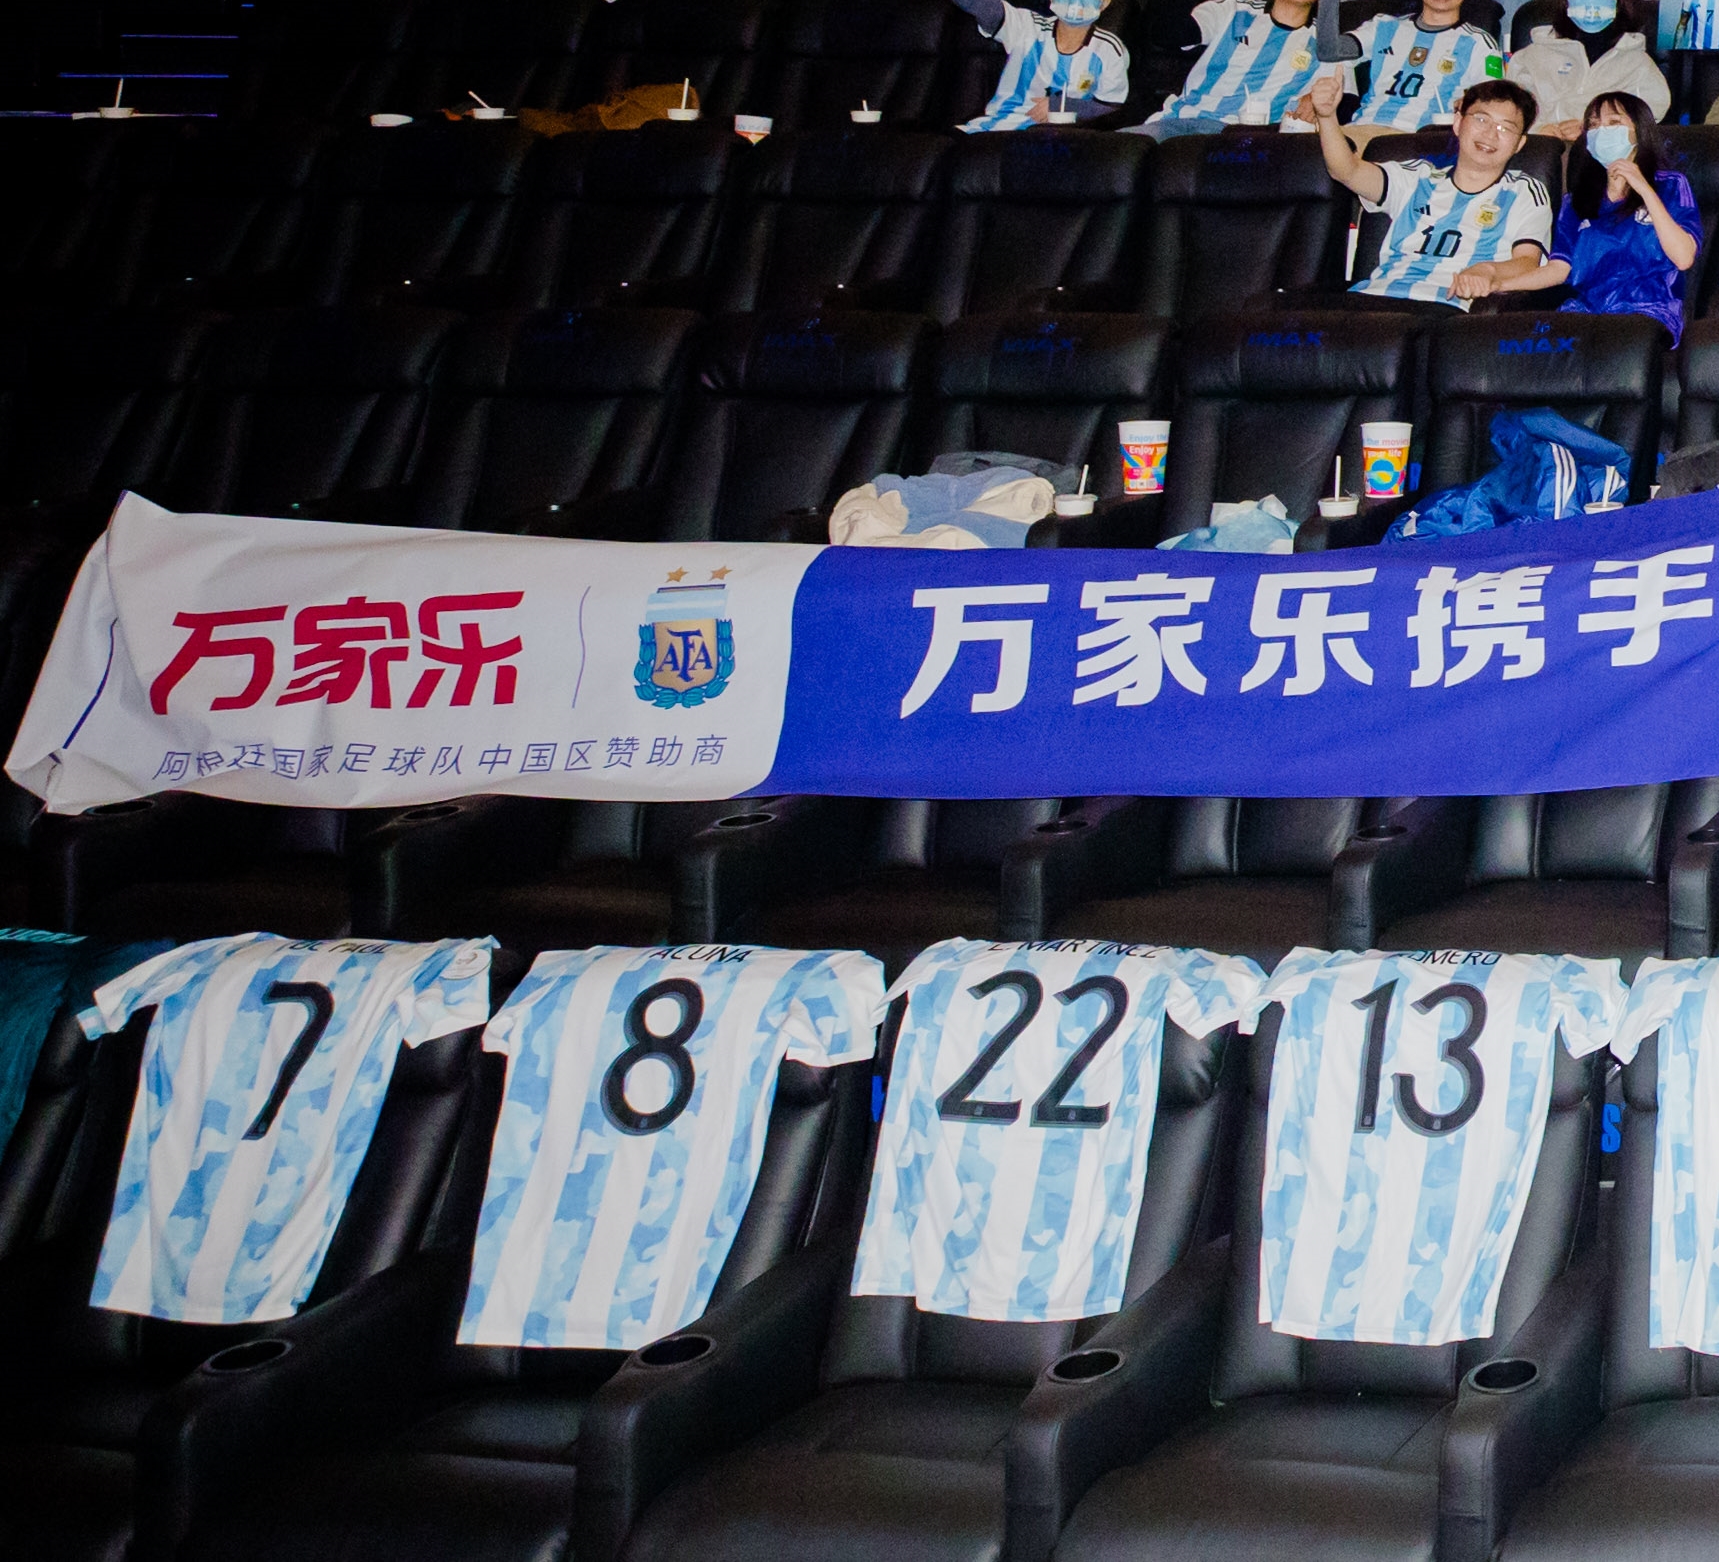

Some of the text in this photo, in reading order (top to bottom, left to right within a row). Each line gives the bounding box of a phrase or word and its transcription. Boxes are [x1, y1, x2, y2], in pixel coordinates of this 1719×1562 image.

[1705, 9, 1714, 21] 7
[1386, 72, 1425, 98] 10
[1414, 226, 1462, 259] 10
[1248, 331, 1322, 346] IMAX
[1499, 338, 1577, 355] IMAX
[1129, 445, 1154, 456] Enjoy
[148, 591, 524, 715] 万家乐
[242, 981, 335, 1141] 7
[601, 977, 705, 1136] 8
[937, 969, 1131, 1130] 22
[1350, 978, 1487, 1138] 13
